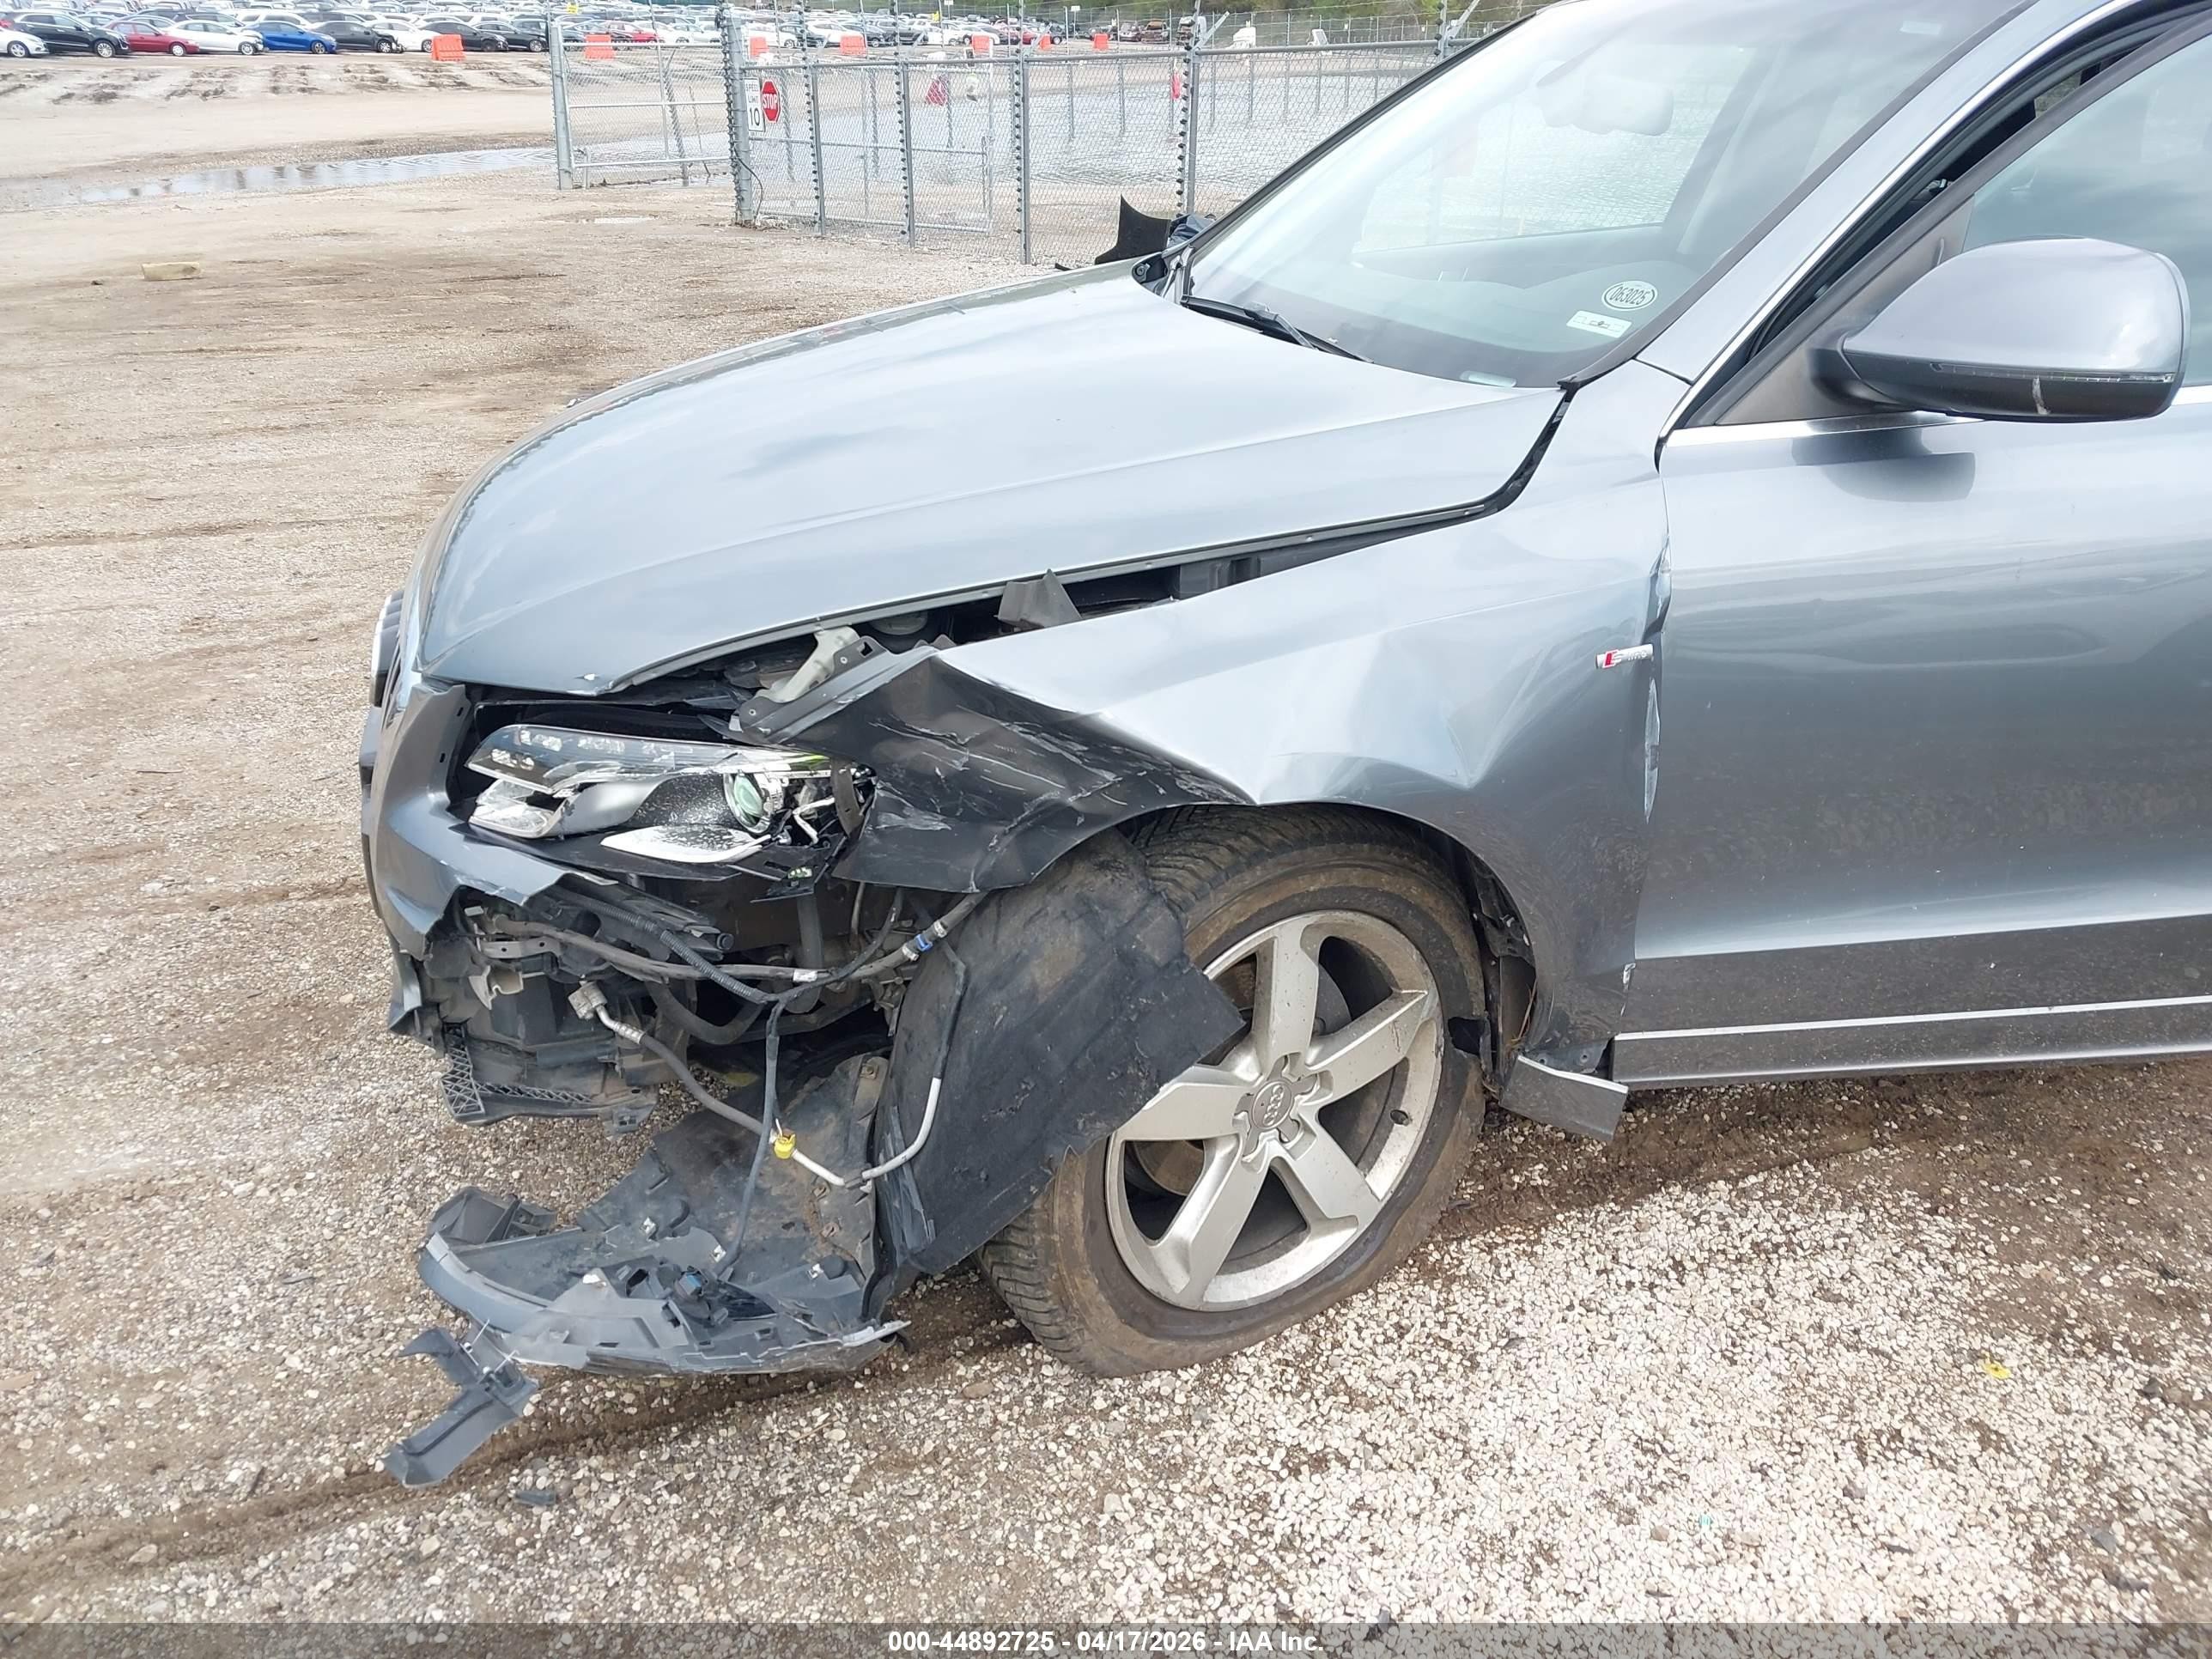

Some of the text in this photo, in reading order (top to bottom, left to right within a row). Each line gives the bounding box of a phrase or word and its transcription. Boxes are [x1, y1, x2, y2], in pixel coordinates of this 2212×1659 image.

[763, 94, 778, 110] STOP
[750, 107, 760, 126] 10
[1609, 286, 1650, 305] 063025
